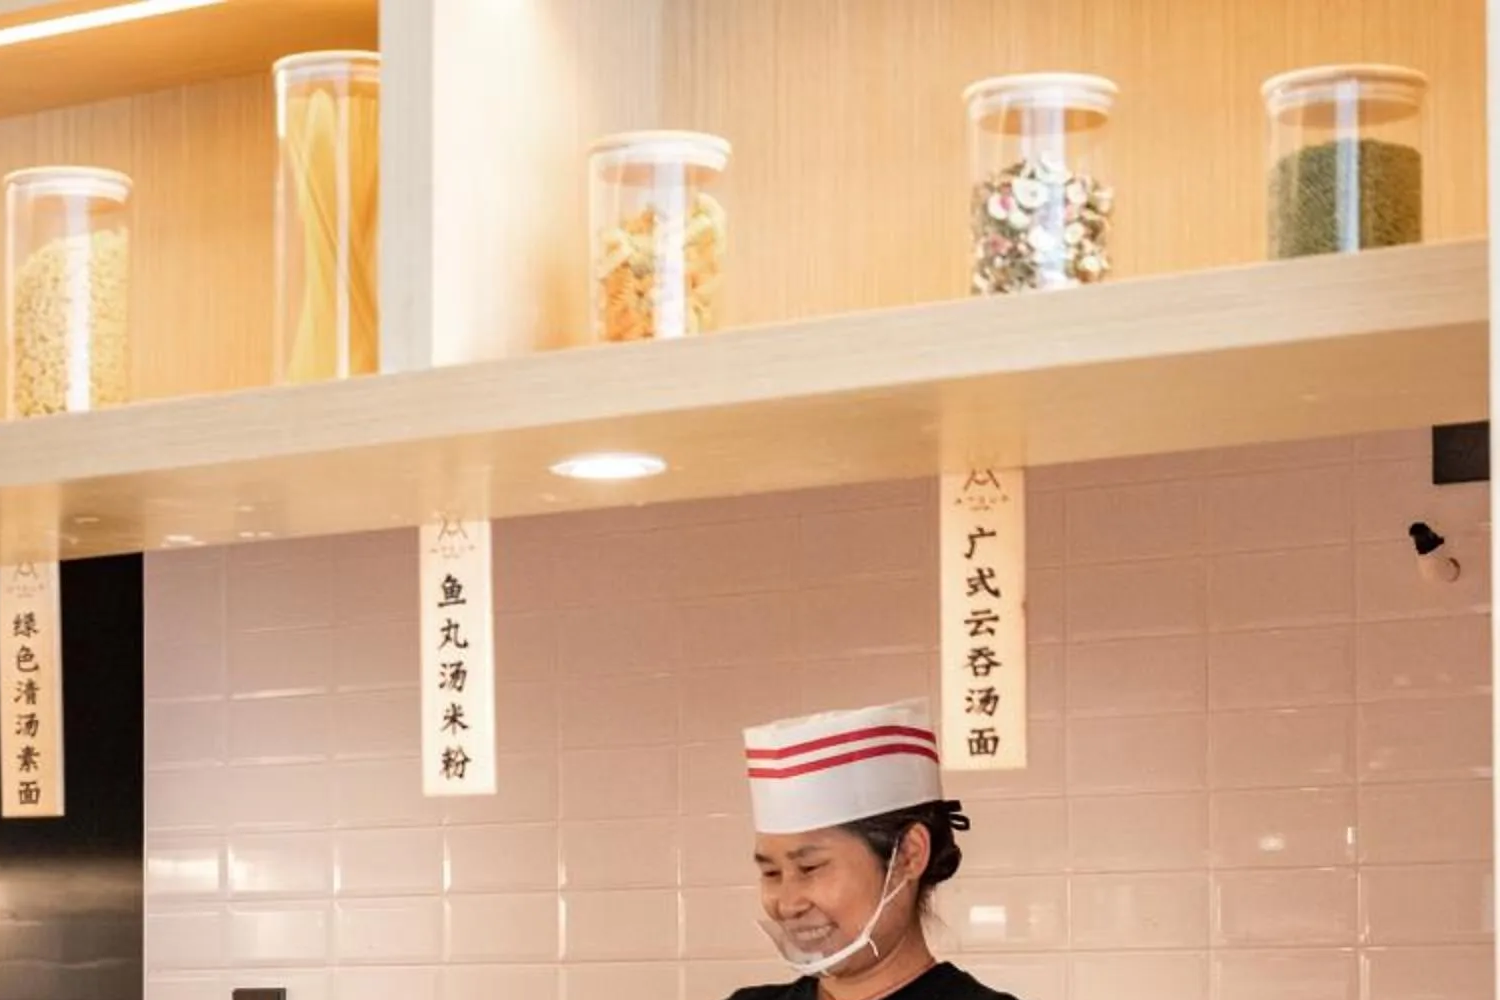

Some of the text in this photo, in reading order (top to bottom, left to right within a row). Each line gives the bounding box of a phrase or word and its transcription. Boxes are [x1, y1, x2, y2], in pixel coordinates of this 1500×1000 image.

[12, 611, 41, 805] 绿色清汤素面
[437, 573, 472, 780] 鱼丸汤米粉
[963, 526, 1003, 758] 广式云吞汤面
